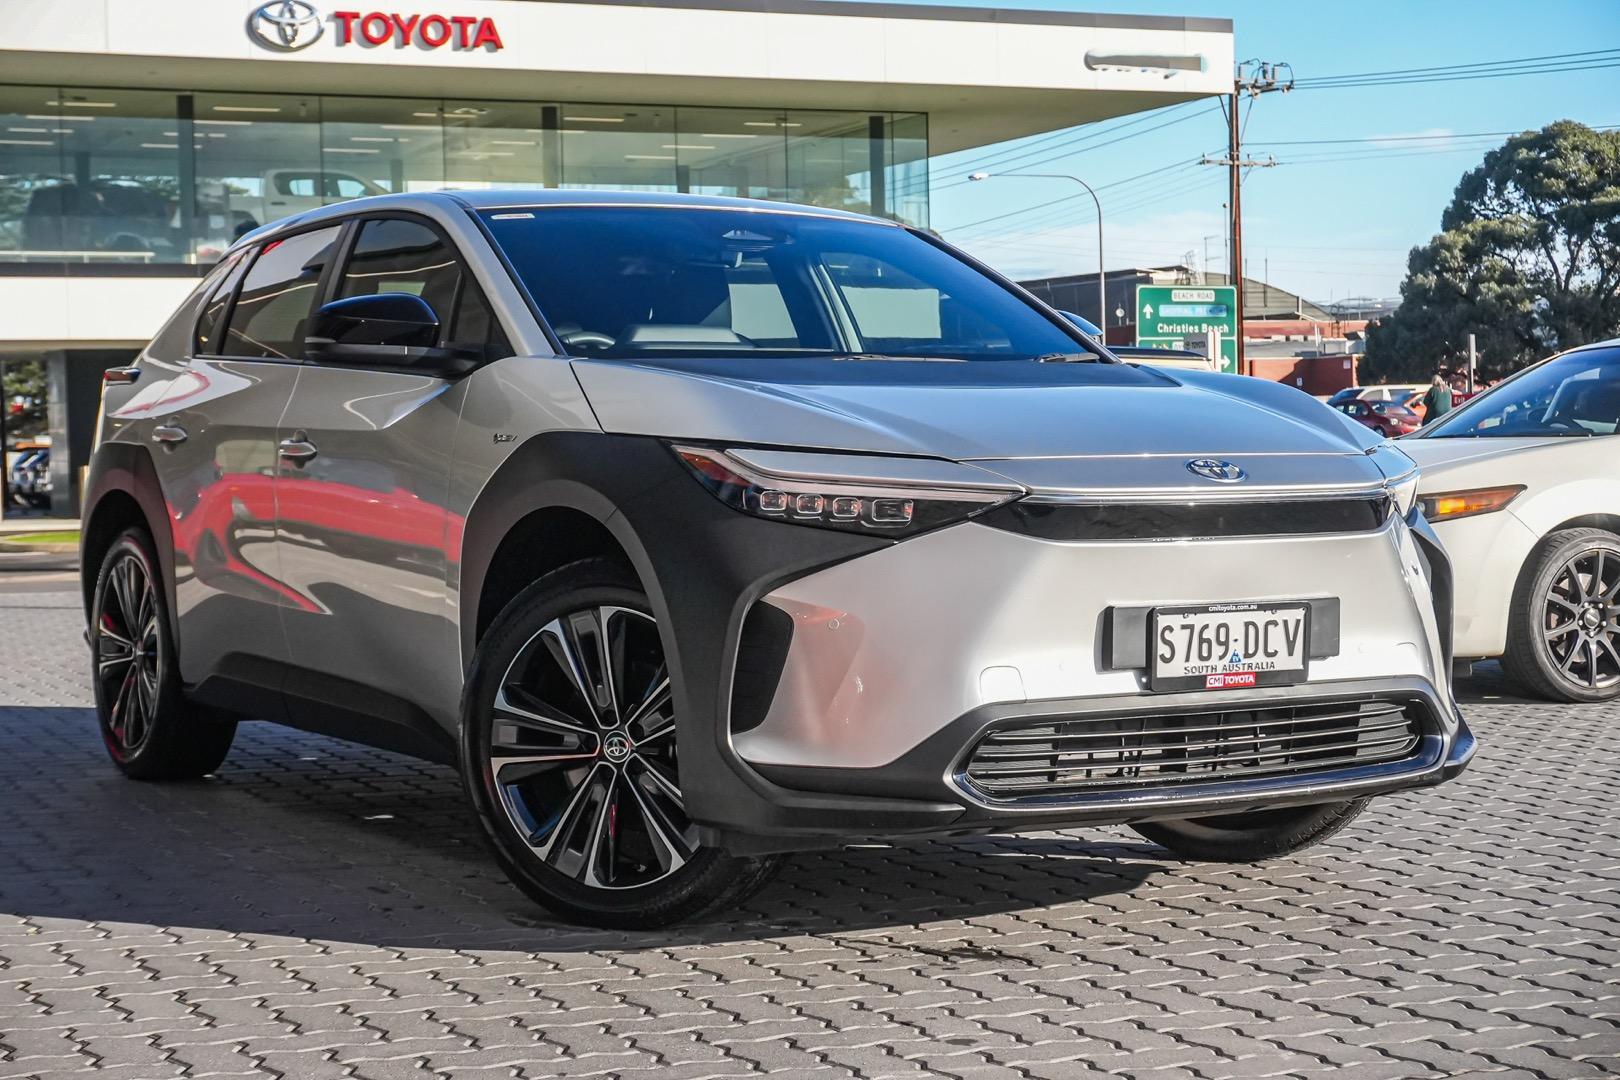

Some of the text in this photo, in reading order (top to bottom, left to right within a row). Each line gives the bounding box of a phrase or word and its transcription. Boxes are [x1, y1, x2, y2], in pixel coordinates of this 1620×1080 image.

[334, 11, 504, 50] TOYOTA
[1173, 292, 1213, 300] BEACH ROAD
[1157, 323, 1199, 333] Christies
[1208, 604, 1258, 613] cmitoyota.com.au
[1184, 661, 1276, 675] SOUTH AUSTRALIA
[1208, 674, 1256, 686] CMI TOYOTA
